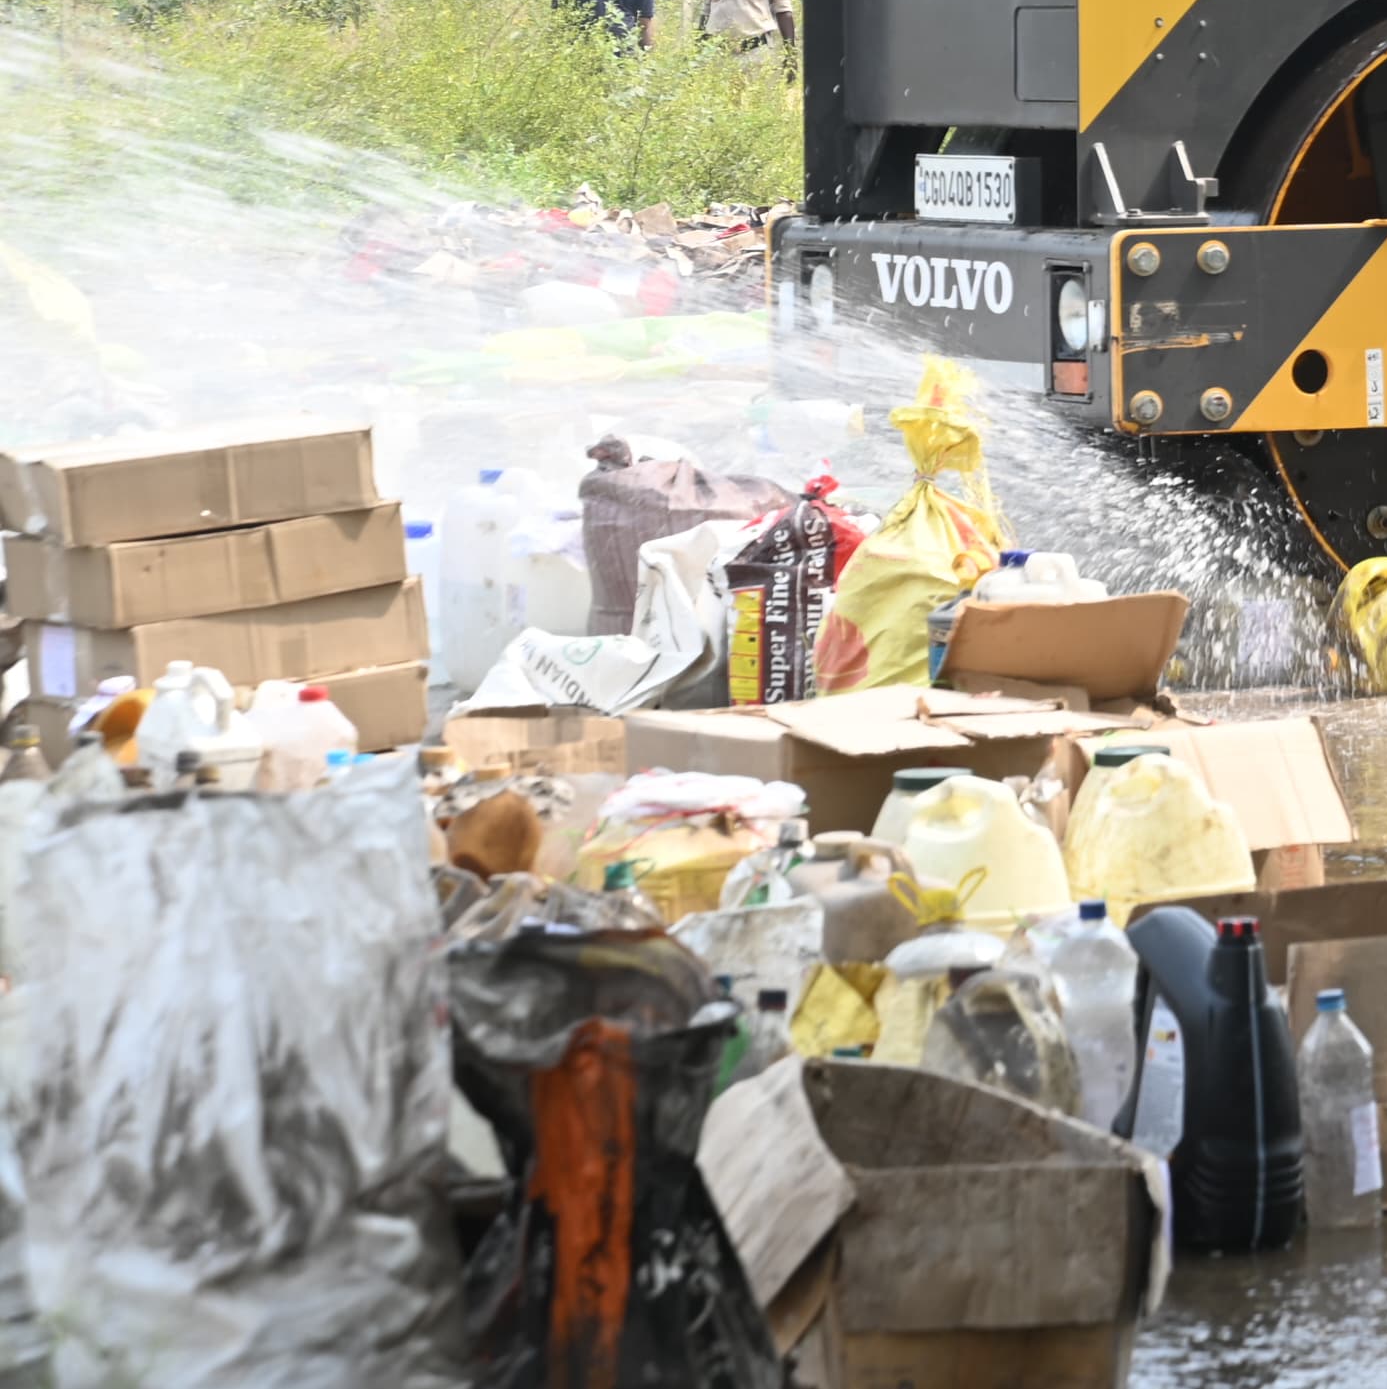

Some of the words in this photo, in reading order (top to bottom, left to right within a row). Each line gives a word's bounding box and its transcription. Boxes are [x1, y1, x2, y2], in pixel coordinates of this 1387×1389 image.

[872, 253, 1013, 315] VOLVO
[765, 571, 790, 624] Fine
[765, 630, 790, 704] Super
